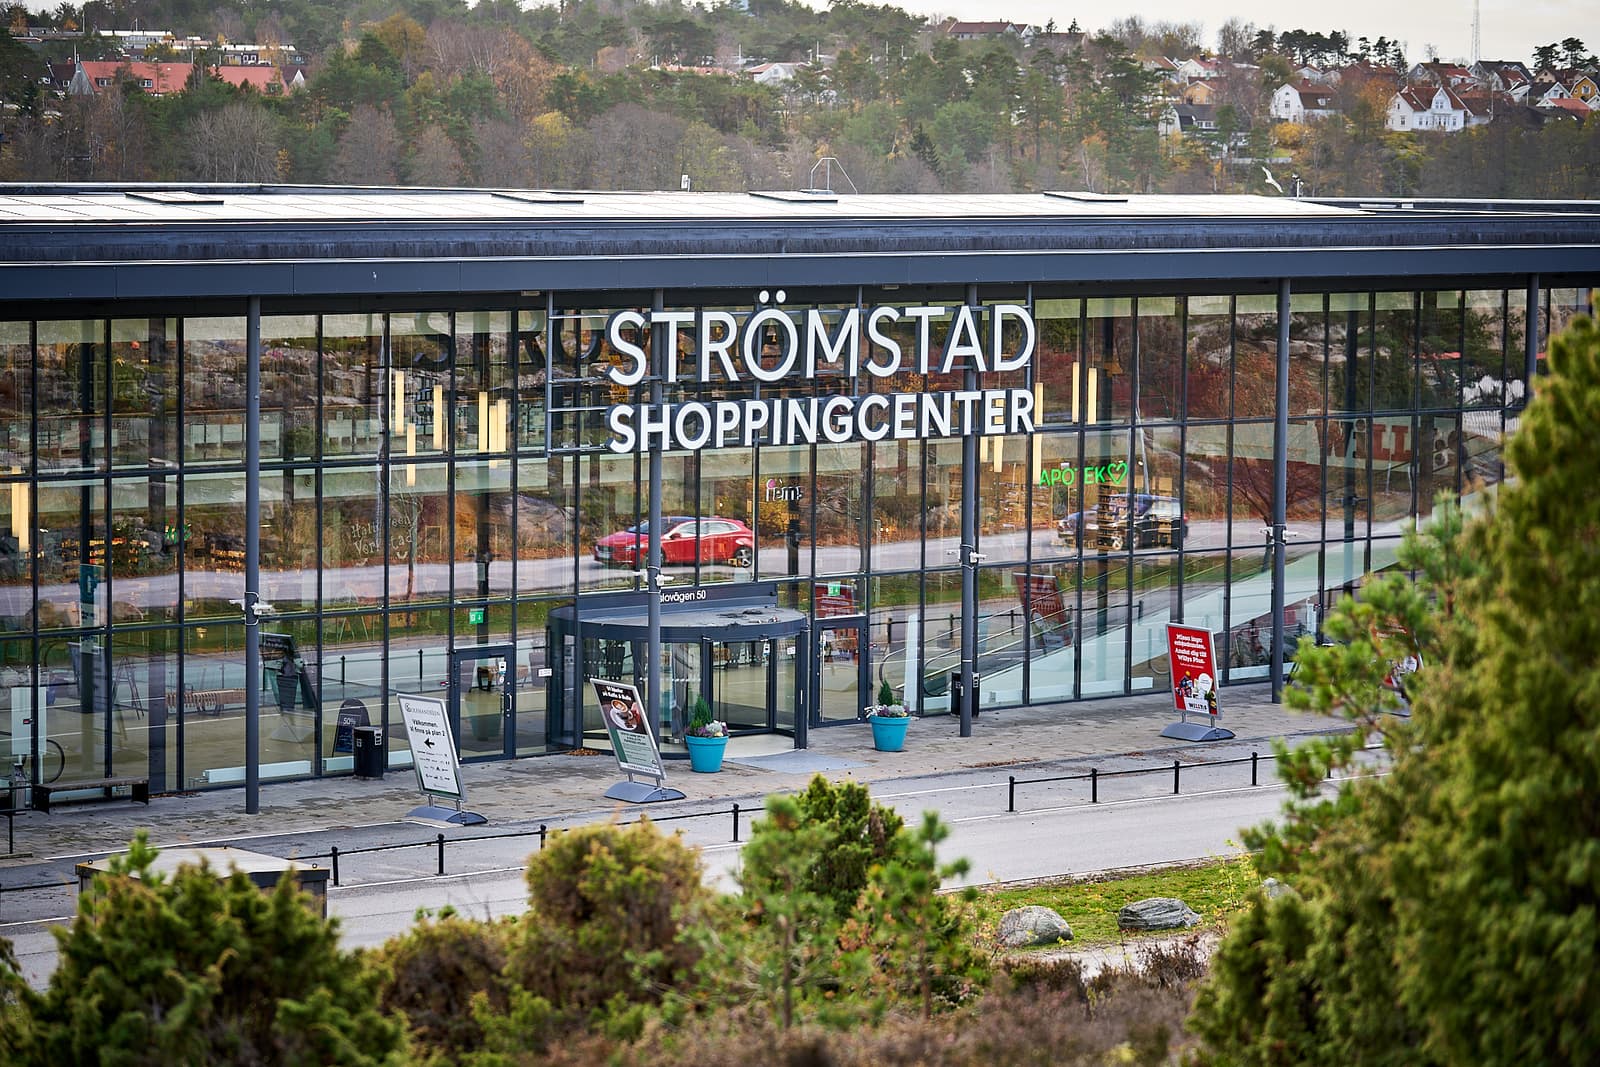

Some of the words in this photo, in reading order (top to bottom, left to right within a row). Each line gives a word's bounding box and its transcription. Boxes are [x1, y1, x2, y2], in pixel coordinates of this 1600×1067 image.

[608, 289, 1036, 386] STRÖMSTAD
[608, 389, 1036, 454] SHOPPINGCENTER
[1039, 464, 1106, 487] APOEK
[696, 590, 706, 600] 50
